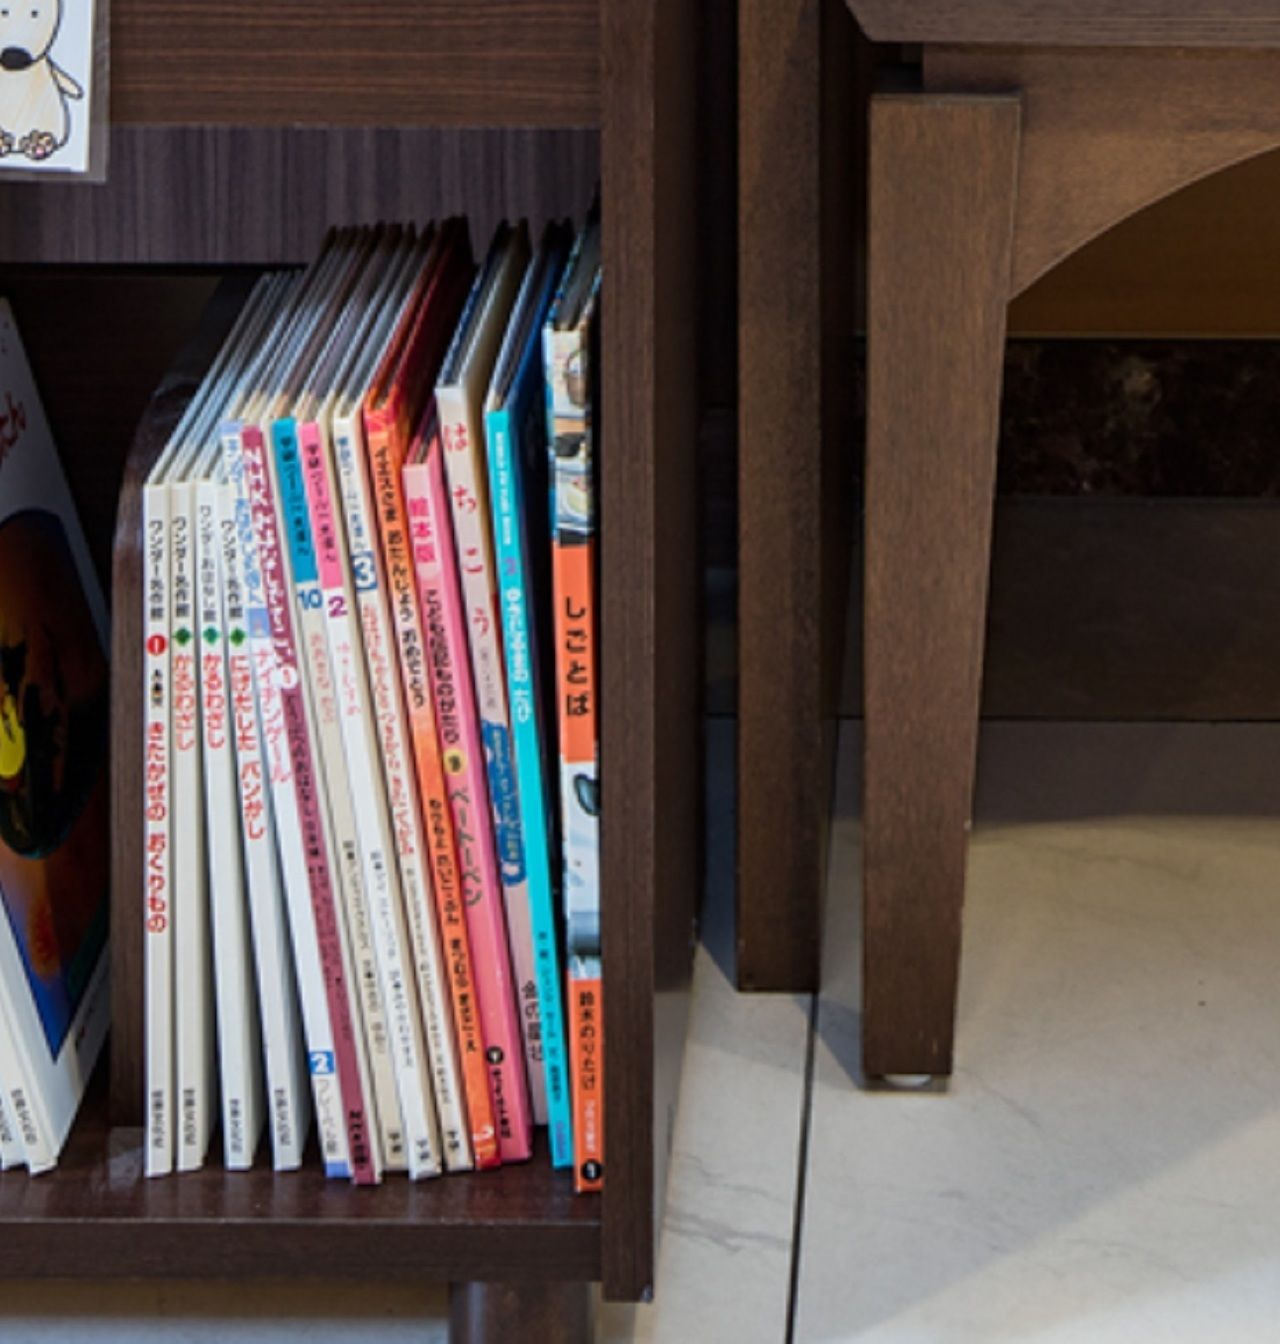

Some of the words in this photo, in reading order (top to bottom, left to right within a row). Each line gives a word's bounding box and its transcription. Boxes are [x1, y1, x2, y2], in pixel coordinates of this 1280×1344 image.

[298, 590, 322, 610] 10
[328, 596, 348, 618] 2
[565, 597, 590, 717] しごとば
[450, 786, 483, 906] ベートーベン
